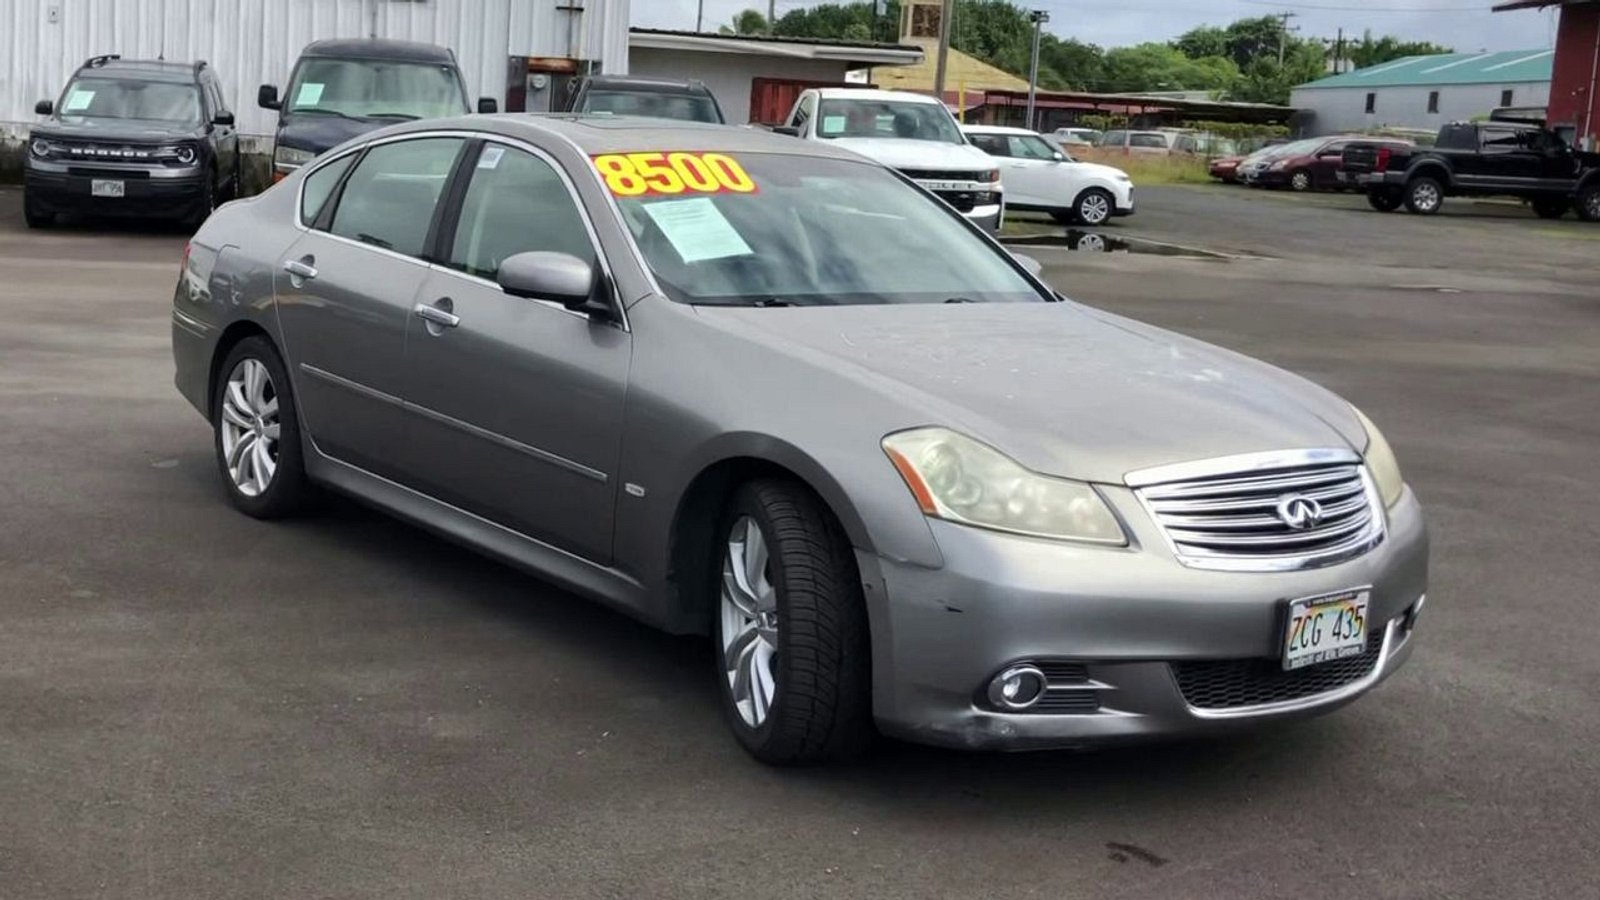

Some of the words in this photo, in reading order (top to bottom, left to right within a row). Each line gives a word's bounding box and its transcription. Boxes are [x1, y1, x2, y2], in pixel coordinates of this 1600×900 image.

[592, 151, 757, 196] 8500
[1289, 612, 1323, 651] ZCG
[1332, 604, 1365, 640] 435
